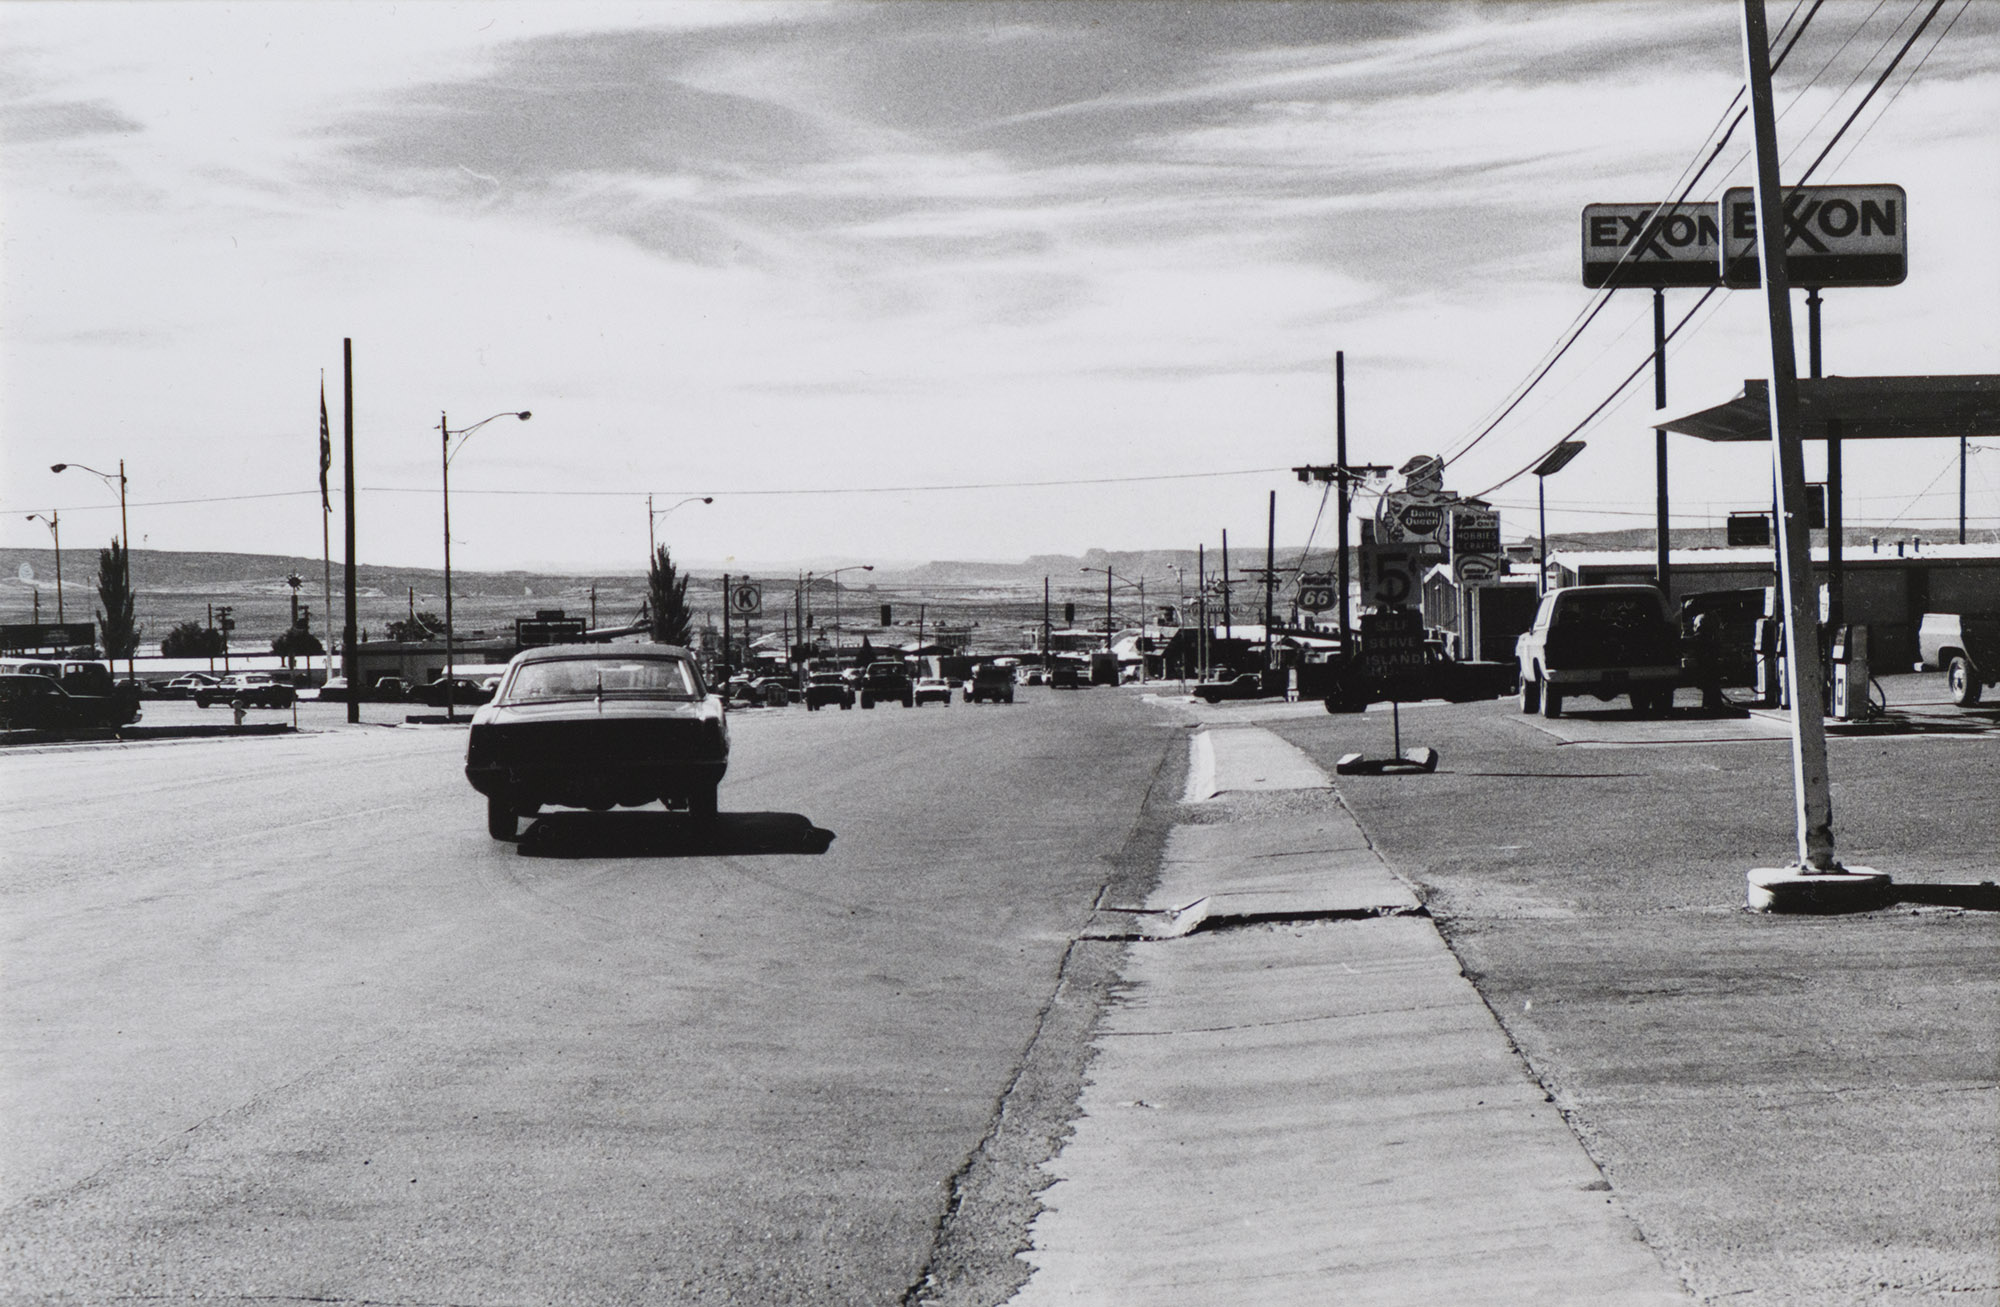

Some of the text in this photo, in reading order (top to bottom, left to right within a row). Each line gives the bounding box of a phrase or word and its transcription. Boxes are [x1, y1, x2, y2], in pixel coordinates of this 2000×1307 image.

[1410, 507, 1438, 518] Dairy
[1405, 517, 1438, 527] Queen
[1457, 531, 1497, 539] HOBBIES
[739, 590, 753, 608] K
[1304, 590, 1329, 605] 66
[1375, 620, 1408, 631] SELF
[1369, 637, 1415, 648] SERVE
[1366, 654, 1421, 665] ISLAND
